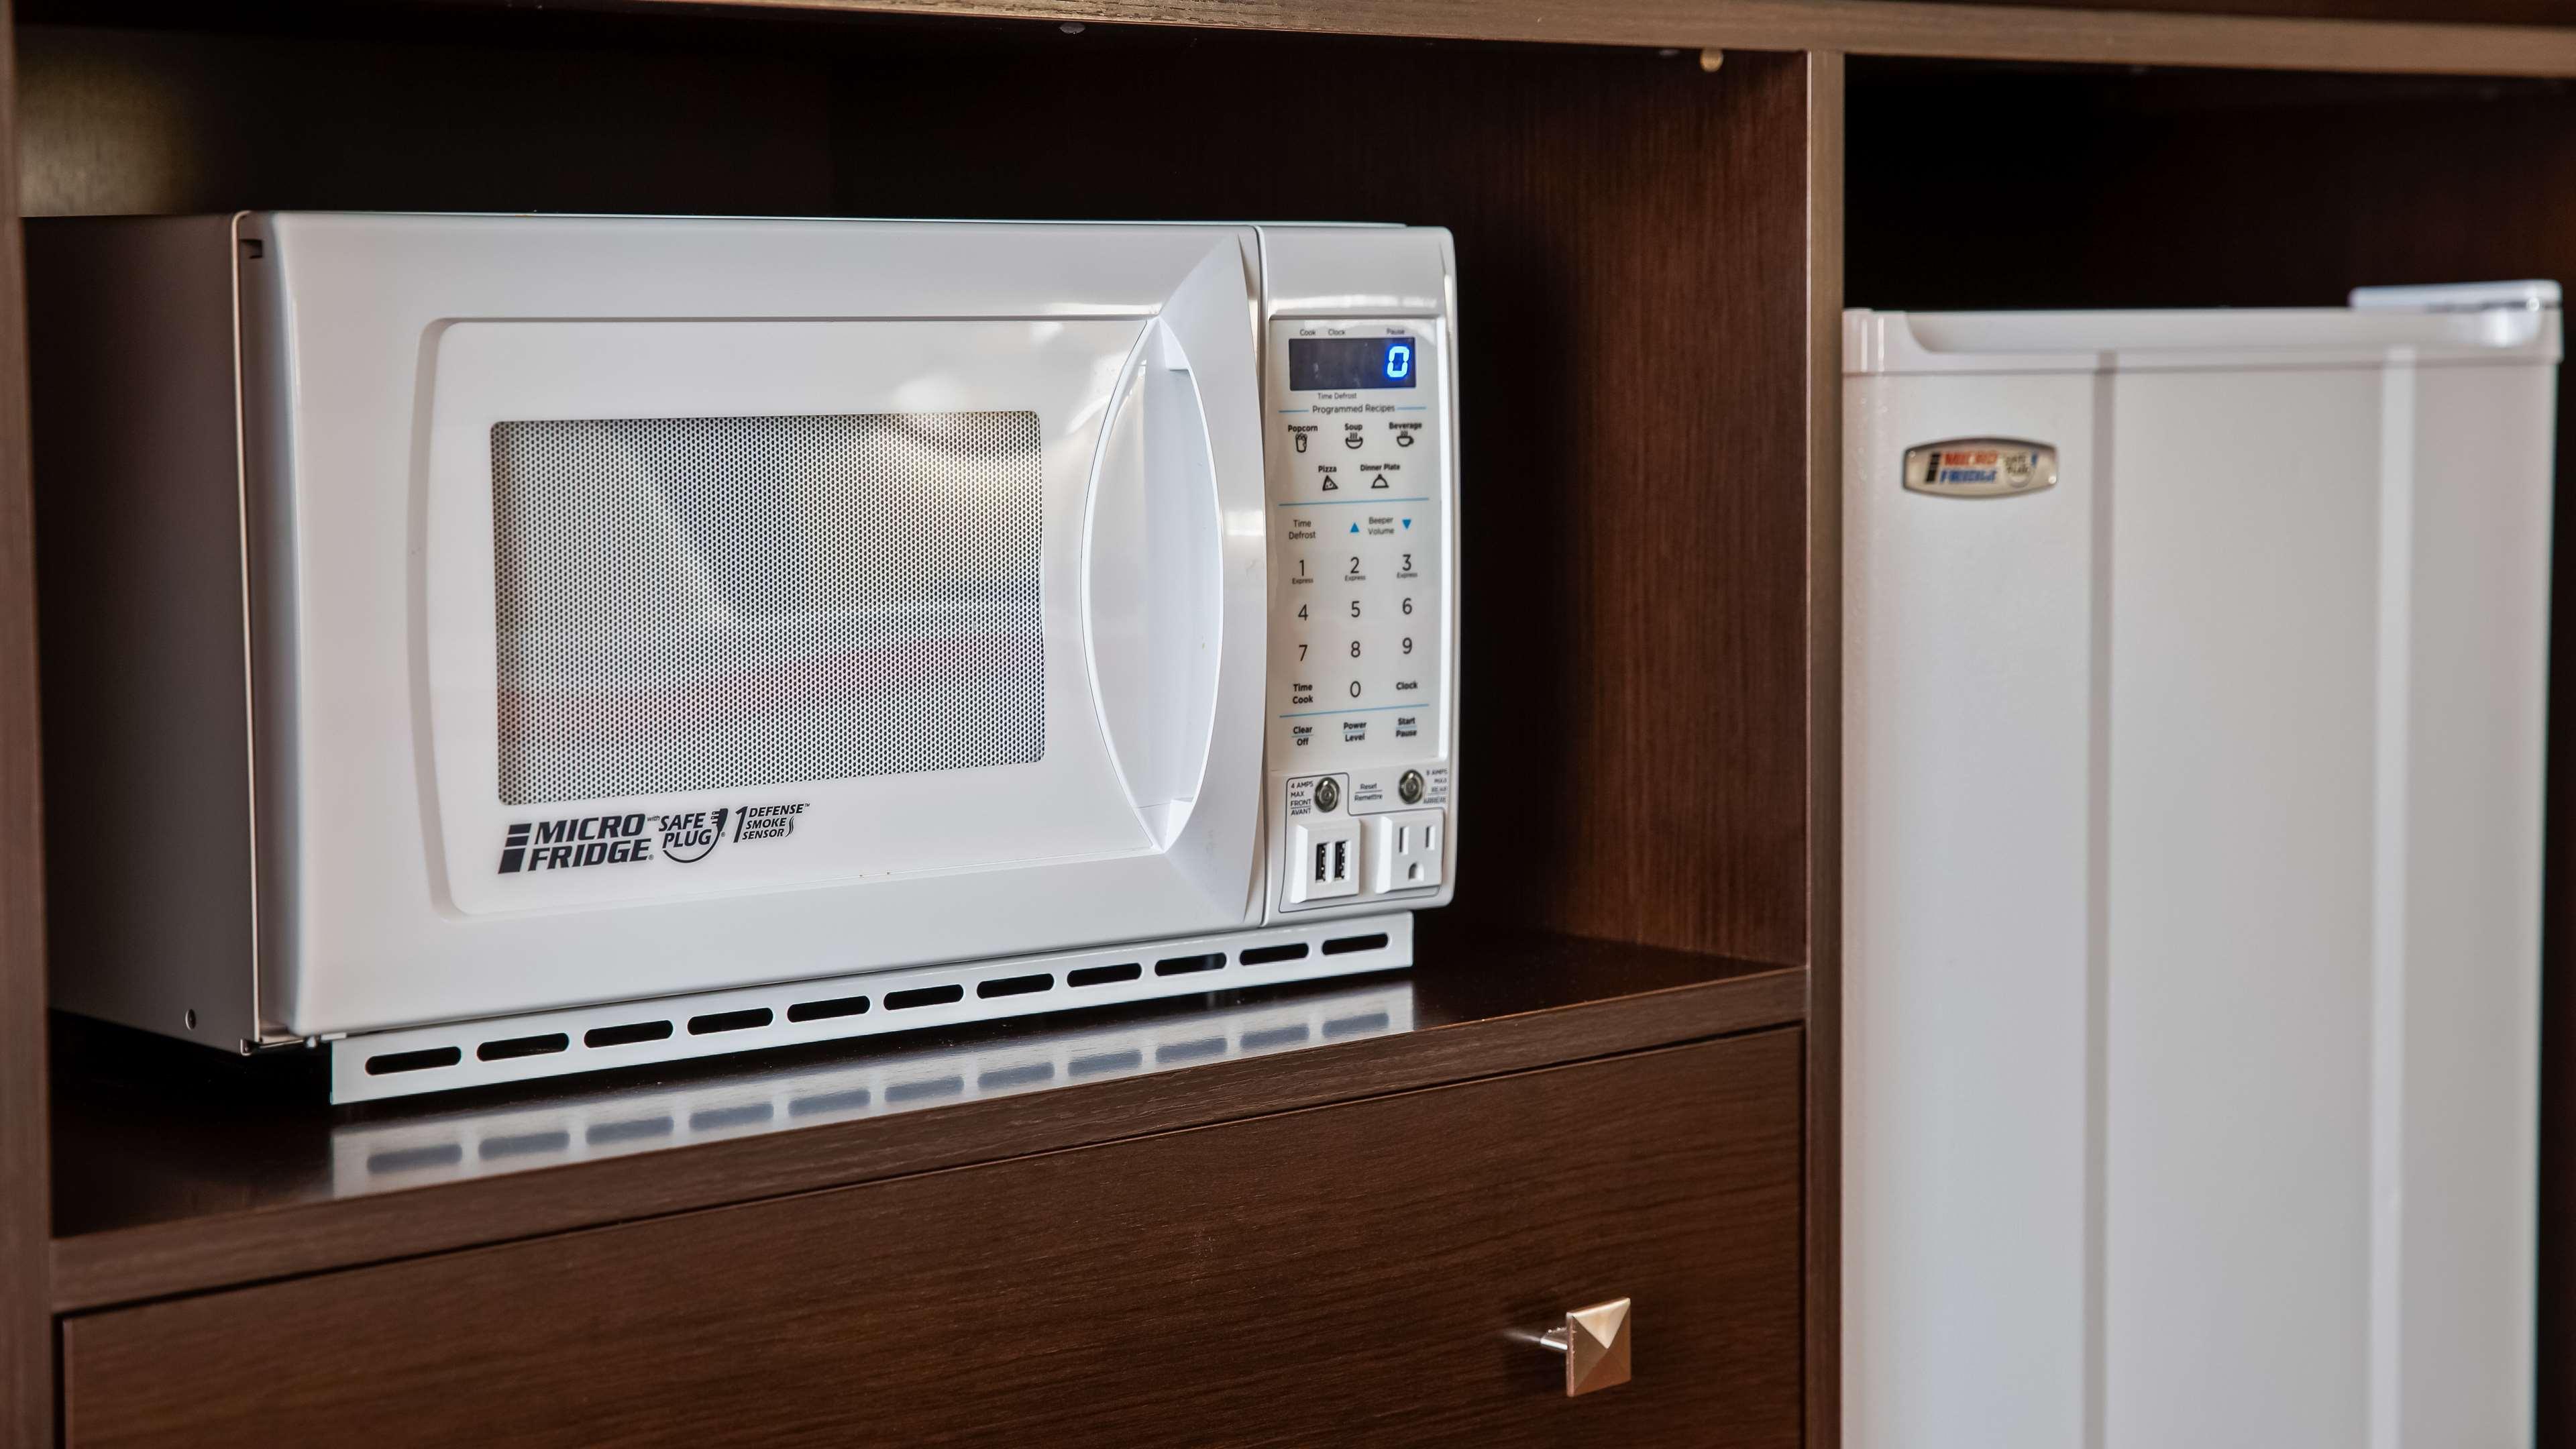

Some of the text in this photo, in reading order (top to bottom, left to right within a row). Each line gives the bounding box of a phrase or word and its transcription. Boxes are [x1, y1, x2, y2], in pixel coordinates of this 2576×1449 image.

[1387, 345, 1409, 378] 0
[1318, 392, 1332, 400] Time
[1312, 405, 1395, 415] Programmed Recipes
[1288, 425, 1318, 433] Popcorn
[1344, 423, 1362, 431] Soup
[1389, 422, 1422, 430] Beverage
[1318, 465, 1337, 473] Pizza
[1360, 463, 1401, 472] Dinner Plate
[1293, 519, 1311, 527] Time
[1368, 517, 1393, 525] Beeper
[1289, 531, 1316, 539] Defrost
[1368, 527, 1395, 535] Volume
[1350, 557, 1360, 574] 2
[1402, 554, 1411, 571] 3
[1299, 559, 1305, 576] 1
[1350, 600, 1360, 617] 5
[1402, 598, 1412, 614] 6
[1297, 604, 1308, 621] 4
[1350, 641, 1360, 657] 8
[1402, 637, 1412, 655] 9
[1299, 644, 1308, 661] 7
[1293, 684, 1313, 692] Time
[1350, 681, 1361, 698] 0
[1396, 681, 1418, 690] Clock
[1293, 695, 1313, 704] Cook
[1344, 721, 1366, 730] Power
[1398, 717, 1415, 725] Start
[1293, 726, 1313, 734] Clear
[1396, 729, 1417, 738] Pause
[1297, 738, 1309, 746] Off
[1345, 734, 1365, 742] Level
[1290, 799, 1311, 807] FRONT
[659, 812, 706, 832] SAFE
[733, 806, 748, 843] 1
[746, 817, 787, 830] SMOKE
[535, 813, 646, 845] MICRO
[662, 828, 712, 849] PLUG
[742, 828, 784, 840] SENSOR
[528, 838, 651, 871] FRIDGE
